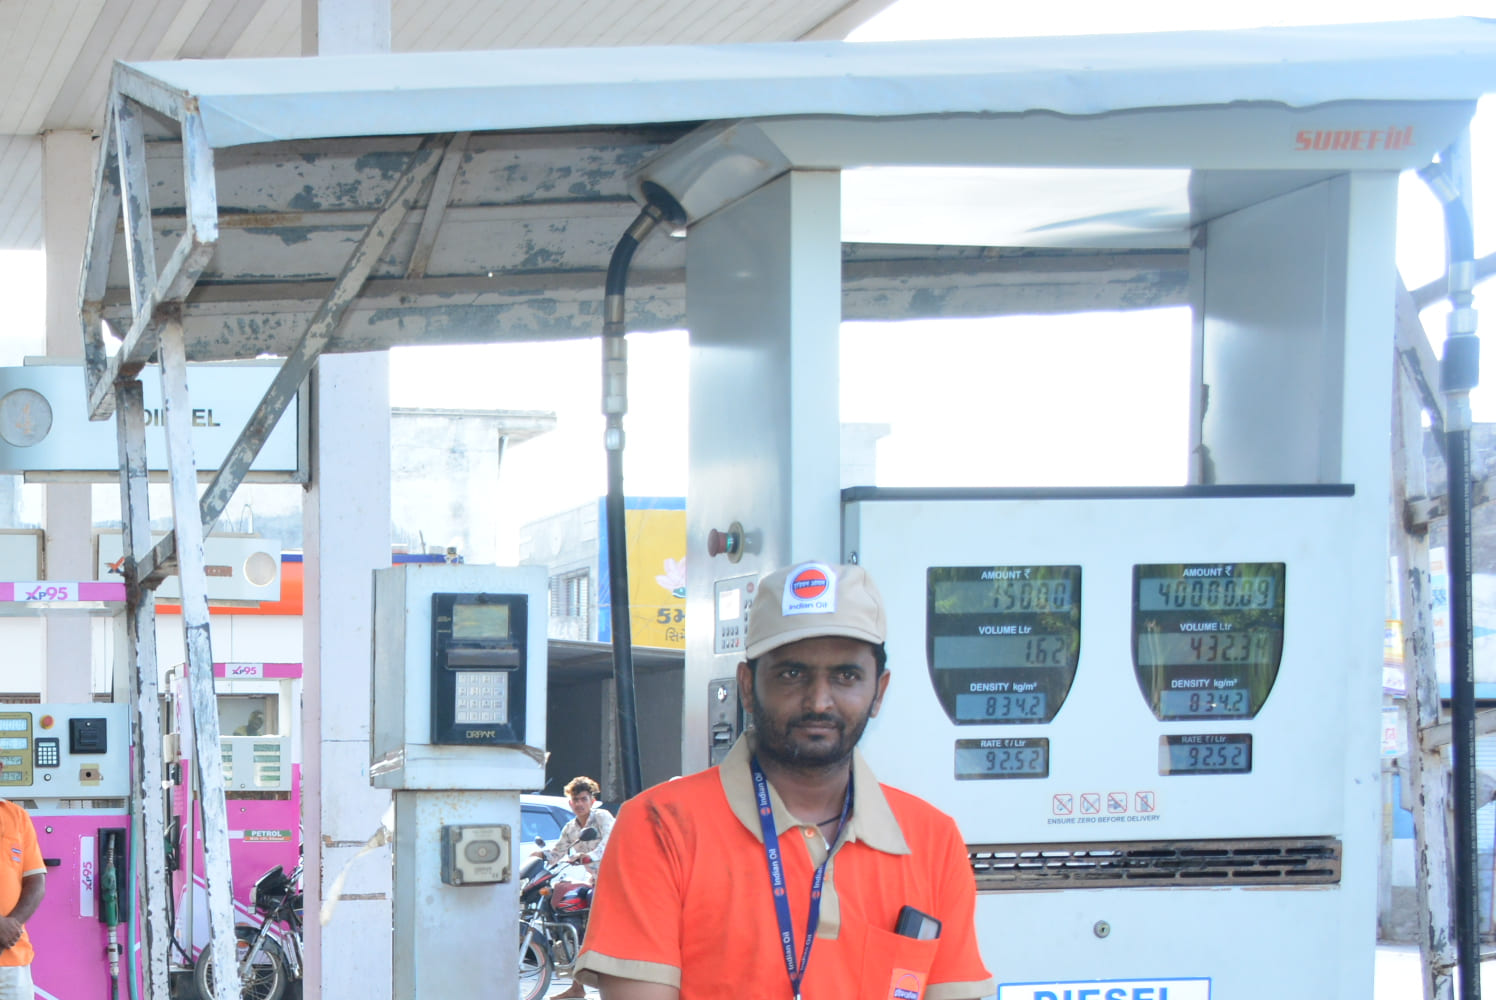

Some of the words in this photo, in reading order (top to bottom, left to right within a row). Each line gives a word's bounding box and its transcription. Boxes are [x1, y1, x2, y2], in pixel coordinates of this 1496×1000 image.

[143, 408, 221, 427] DIEL
[981, 570, 1021, 580] AMOUNT
[1183, 567, 1222, 577] AMOUNT
[979, 626, 1016, 635] VOLUME
[1018, 625, 1032, 634] Ltr
[1180, 623, 1218, 632] VOLUME
[1219, 622, 1232, 631] Ltr
[970, 682, 1009, 692] DENSITY
[1170, 679, 1210, 689] DENSITY
[985, 696, 1041, 717] 834.2
[980, 740, 1001, 748] RATE
[1181, 735, 1202, 744] RATE
[985, 750, 1041, 771] 92.52
[1188, 746, 1243, 767] 92.52
[758, 782, 769, 806] Indian
[1047, 817, 1076, 825] ENSURE
[1077, 816, 1097, 824] ZERO
[1126, 814, 1161, 823] DELIVERY
[768, 848, 778, 860] Oil
[771, 861, 782, 886] Indian
[782, 931, 791, 944] Oil
